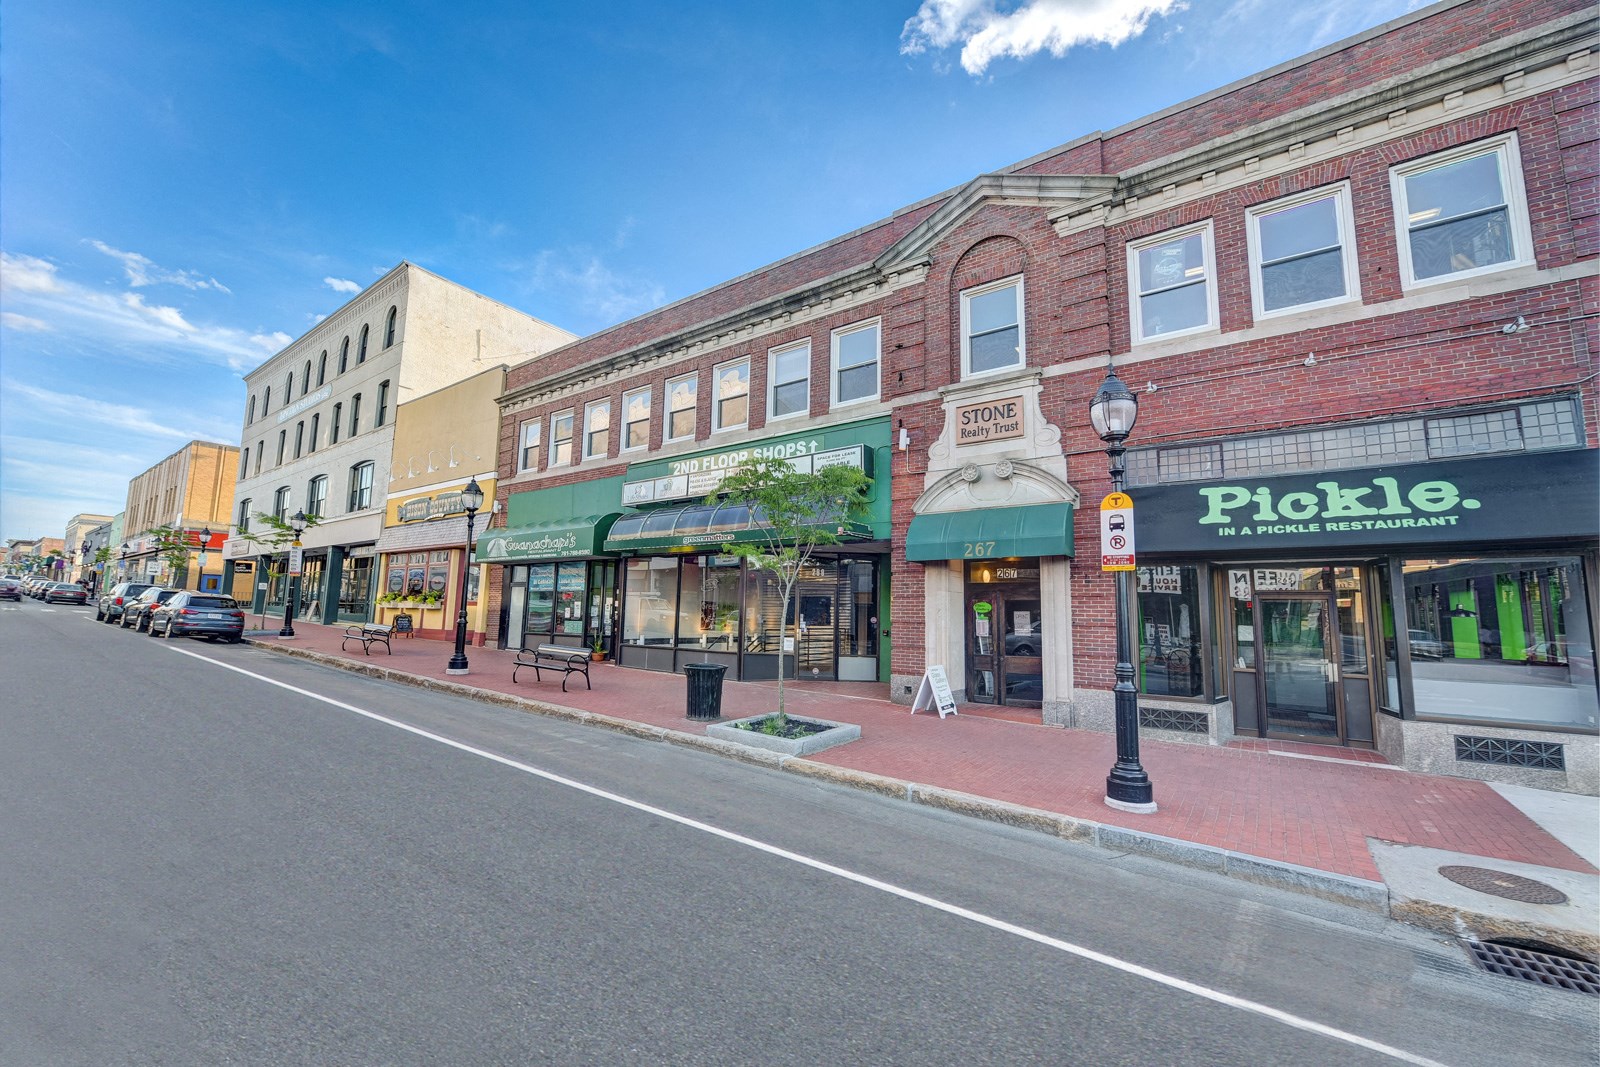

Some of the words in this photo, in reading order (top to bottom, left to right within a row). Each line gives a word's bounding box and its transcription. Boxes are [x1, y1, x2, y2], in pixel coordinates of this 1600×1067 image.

[961, 402, 1017, 425] STONE
[961, 426, 990, 438] Realty
[993, 421, 1019, 434] Trust
[673, 461, 699, 475] 2ND
[703, 451, 748, 471] FLOOR
[753, 441, 807, 461] SHOPS
[1111, 497, 1121, 505] T
[1199, 477, 1481, 524] Pickle.
[1218, 527, 1235, 536] IN
[1240, 526, 1252, 535] A
[1257, 523, 1320, 534] PICKLE
[1326, 516, 1459, 531] RESTAURANT
[505, 532, 576, 551] Guanachapi's
[683, 533, 735, 544] greenmatters
[964, 541, 995, 557] 267
[997, 568, 1016, 578] 267
